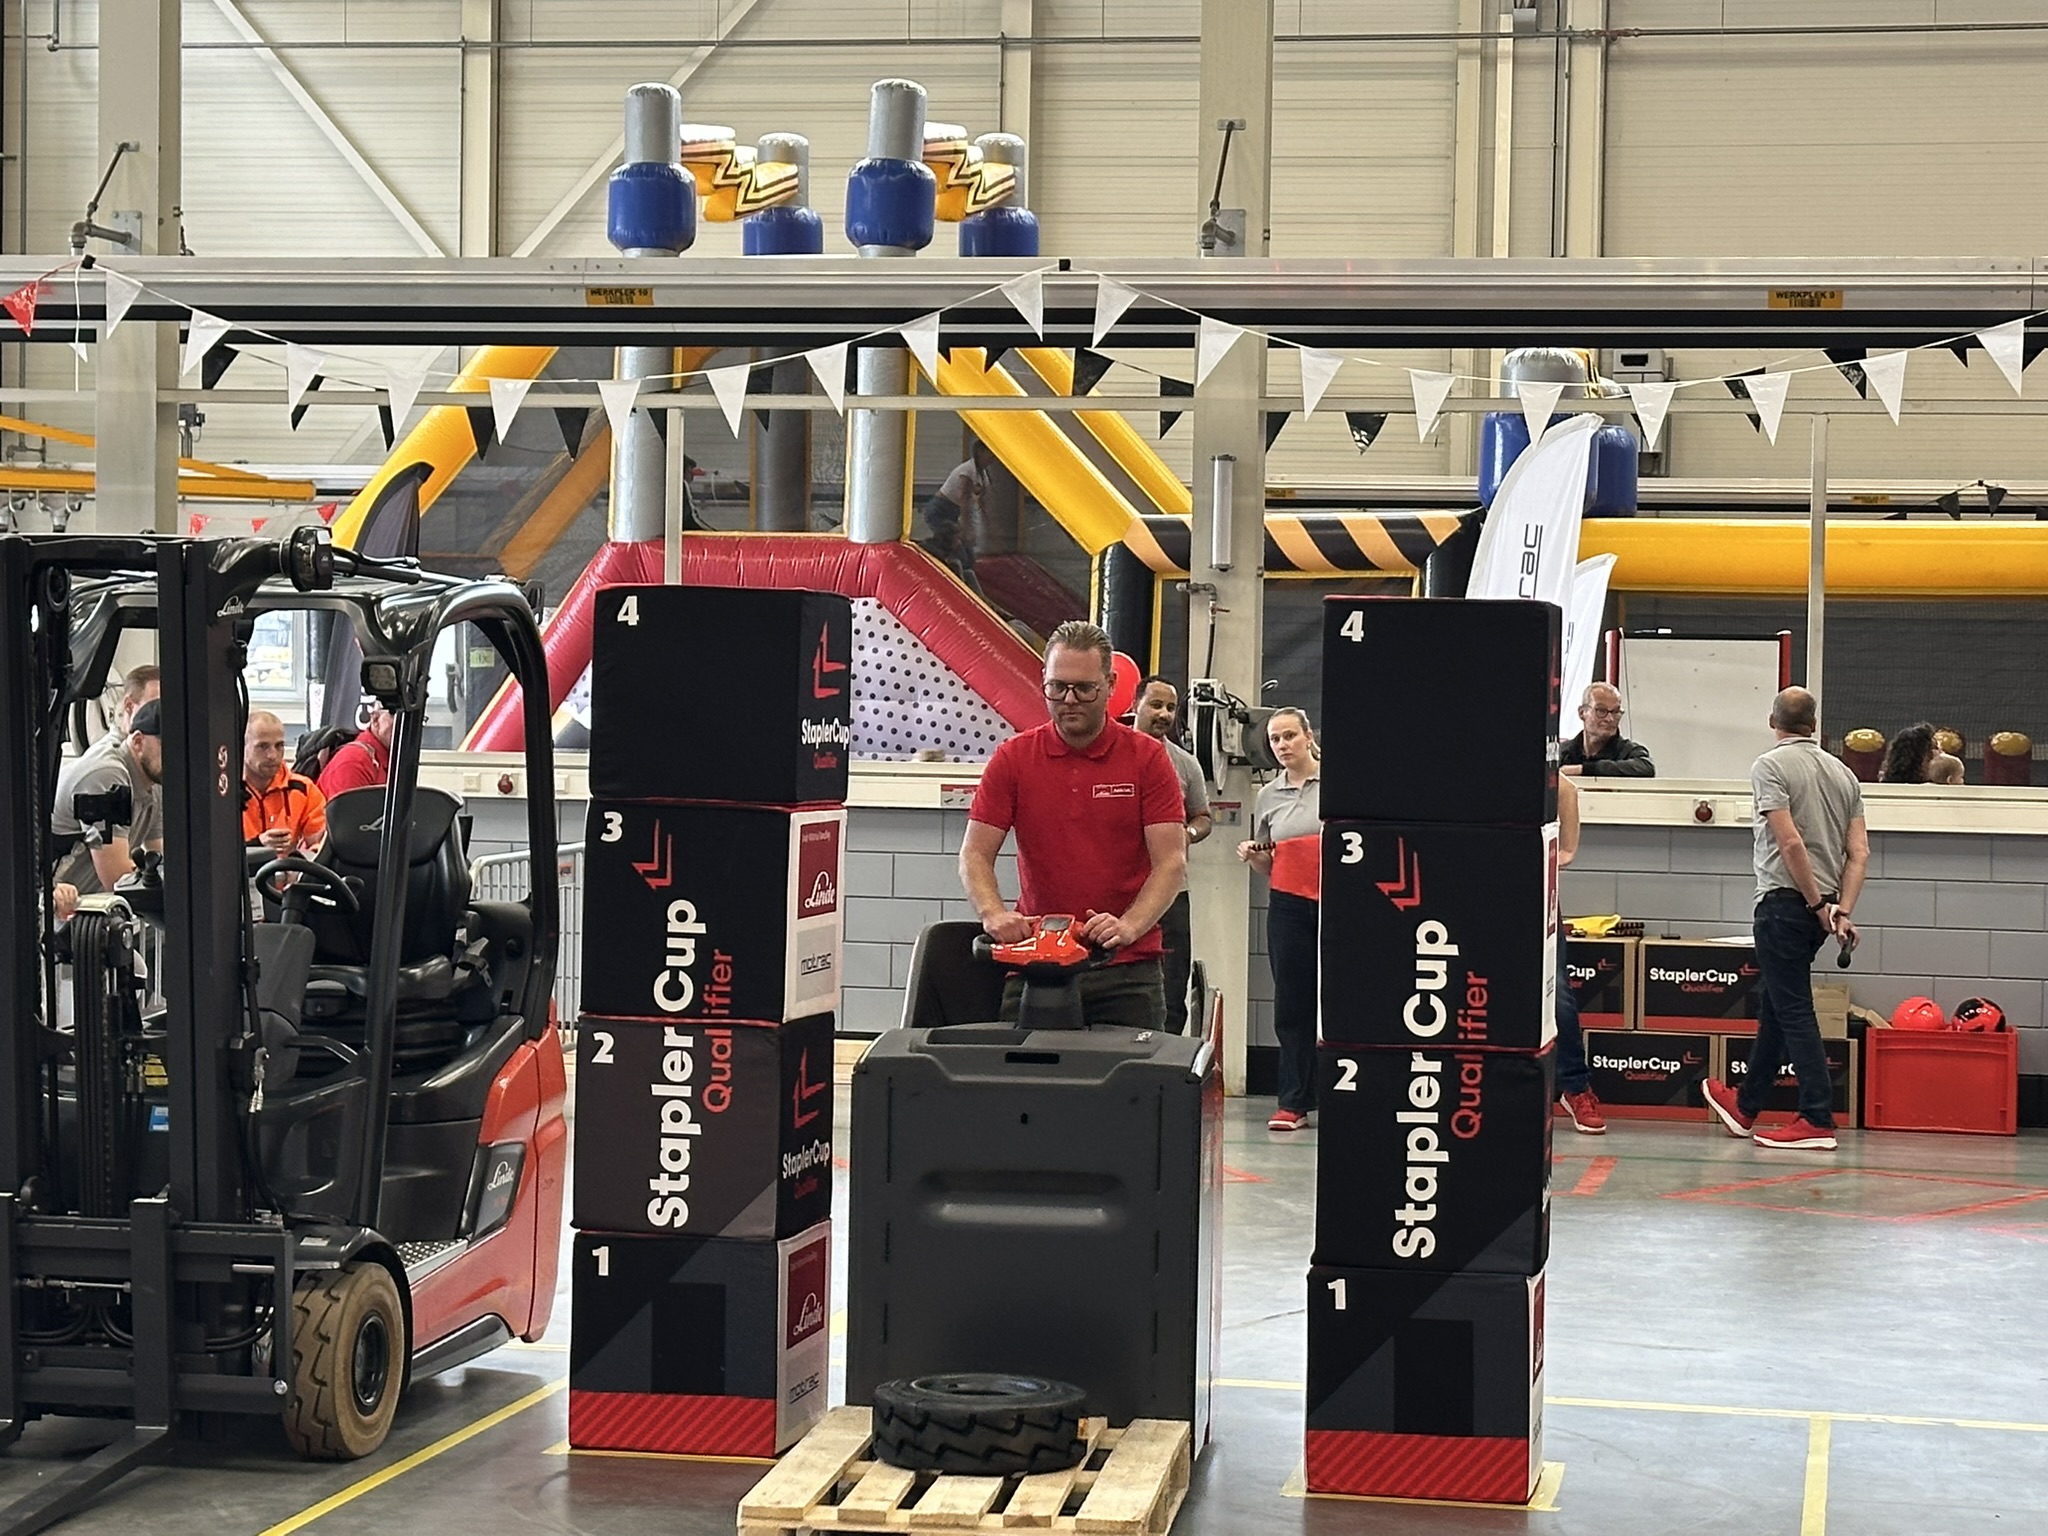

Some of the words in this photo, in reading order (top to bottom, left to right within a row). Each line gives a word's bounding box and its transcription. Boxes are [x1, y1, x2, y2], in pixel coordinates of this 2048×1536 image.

[1775, 290, 1826, 299] WERKPLEK
[617, 595, 640, 626] 4
[1340, 610, 1365, 642] 4
[801, 717, 850, 751] StaplerCup
[600, 811, 624, 843] 3
[1340, 831, 1365, 864] 3
[804, 871, 836, 909] Linde
[1649, 967, 1739, 985] StaplerCup
[591, 1031, 615, 1064] 2
[1592, 1055, 1681, 1072] StaplerCup
[1333, 1058, 1359, 1091] 2
[782, 1138, 830, 1179] StaplerCup
[487, 1160, 514, 1191] Linde
[591, 1245, 610, 1276] 1
[1327, 1278, 1347, 1310] 1
